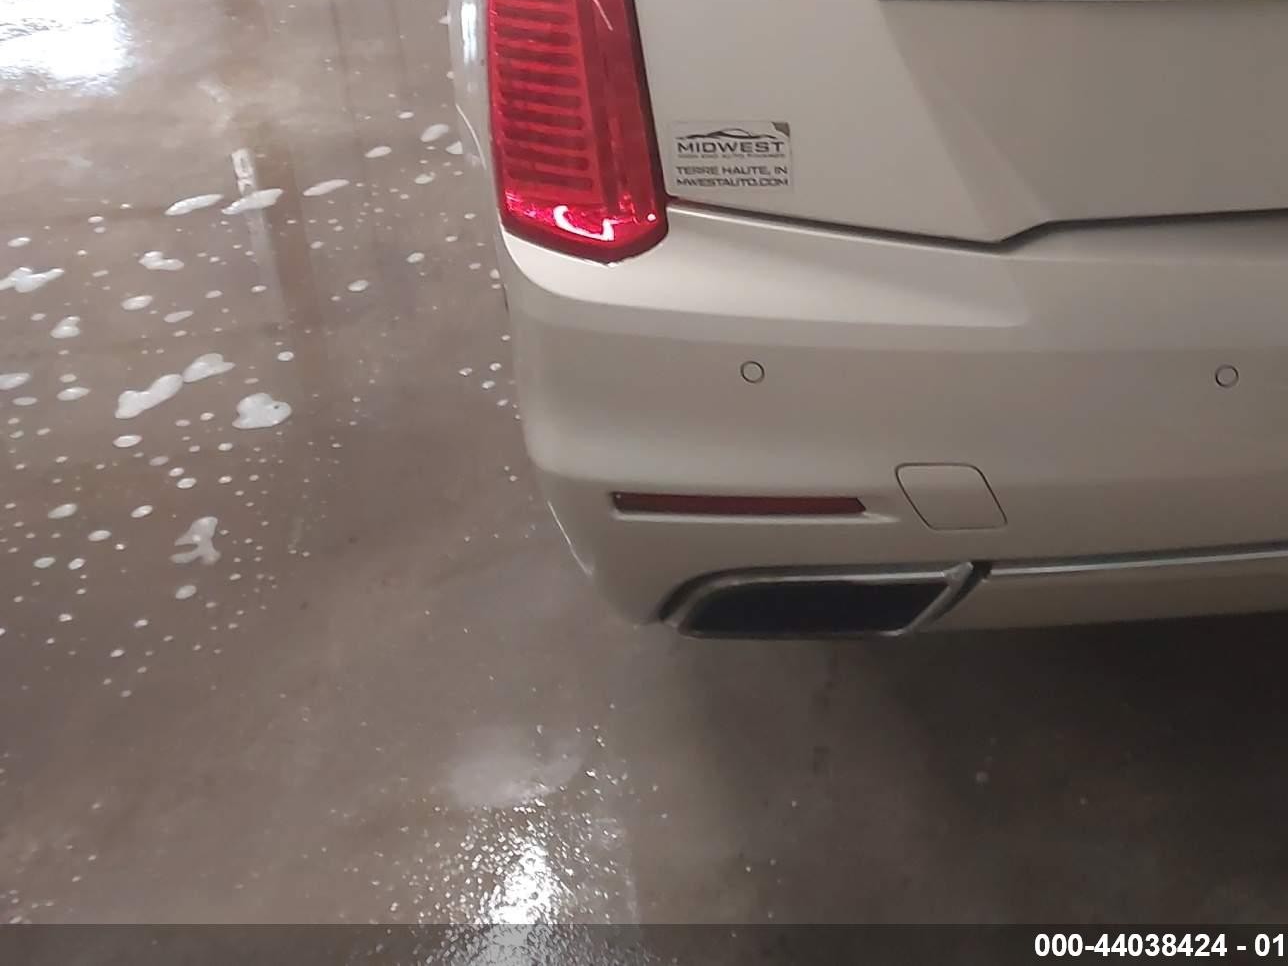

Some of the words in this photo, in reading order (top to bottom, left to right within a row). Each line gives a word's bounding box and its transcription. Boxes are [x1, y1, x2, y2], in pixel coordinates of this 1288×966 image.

[677, 141, 785, 153] MIDWEST
[676, 166, 719, 175] TERRE
[774, 166, 788, 175] IN
